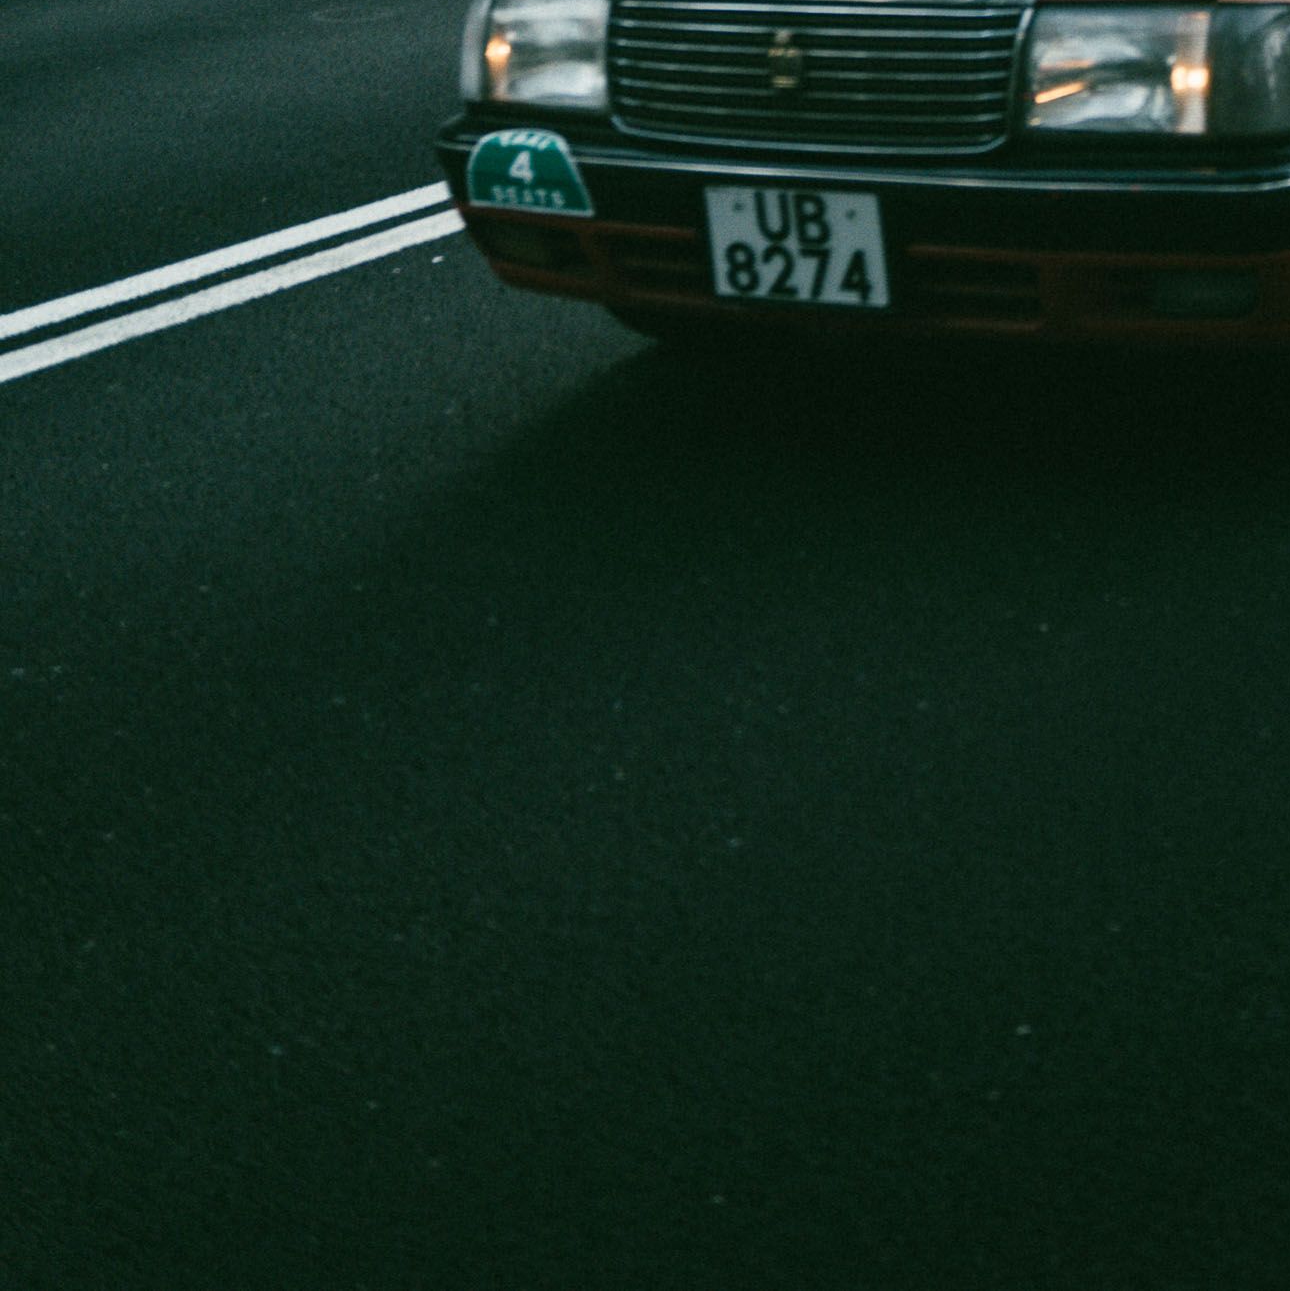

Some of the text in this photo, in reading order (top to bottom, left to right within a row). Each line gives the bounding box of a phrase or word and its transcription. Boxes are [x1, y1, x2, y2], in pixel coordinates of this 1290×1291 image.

[509, 150, 534, 184] 4
[491, 185, 566, 208] SEATS
[753, 190, 831, 245] UB
[725, 241, 873, 304] 8274
